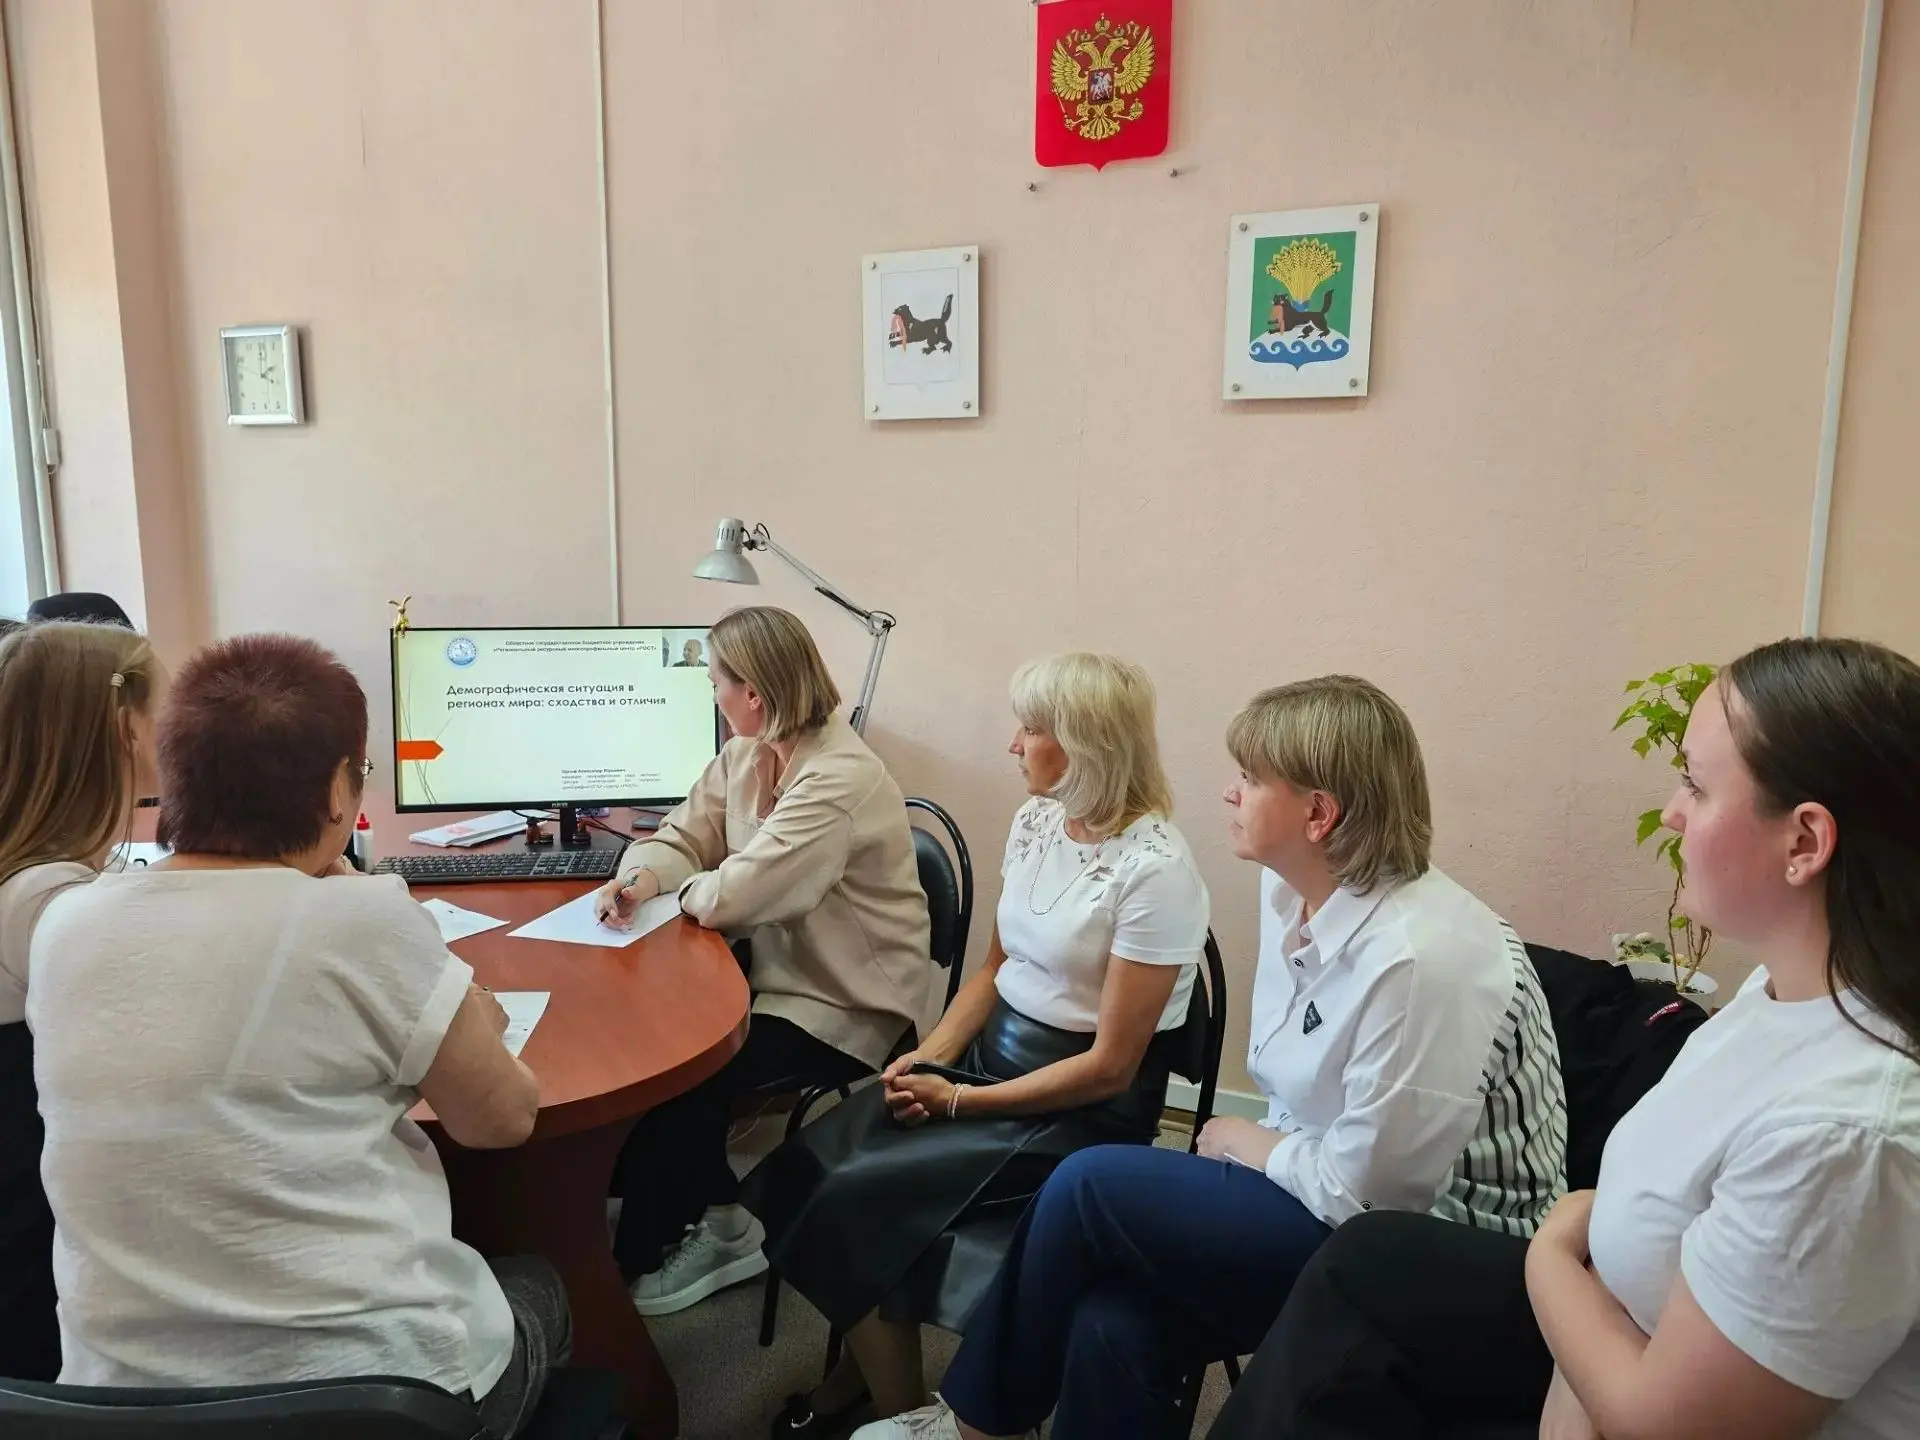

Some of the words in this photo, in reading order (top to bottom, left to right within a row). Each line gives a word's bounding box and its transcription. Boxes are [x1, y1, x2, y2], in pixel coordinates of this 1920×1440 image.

[447, 684, 564, 696] Демографическая
[567, 684, 625, 694] ситуация
[628, 684, 635, 692] в
[447, 698, 506, 710] регионах
[508, 698, 545, 709] мира:
[548, 697, 606, 708] сходства
[609, 697, 616, 706] и
[619, 696, 666, 705] отличия
